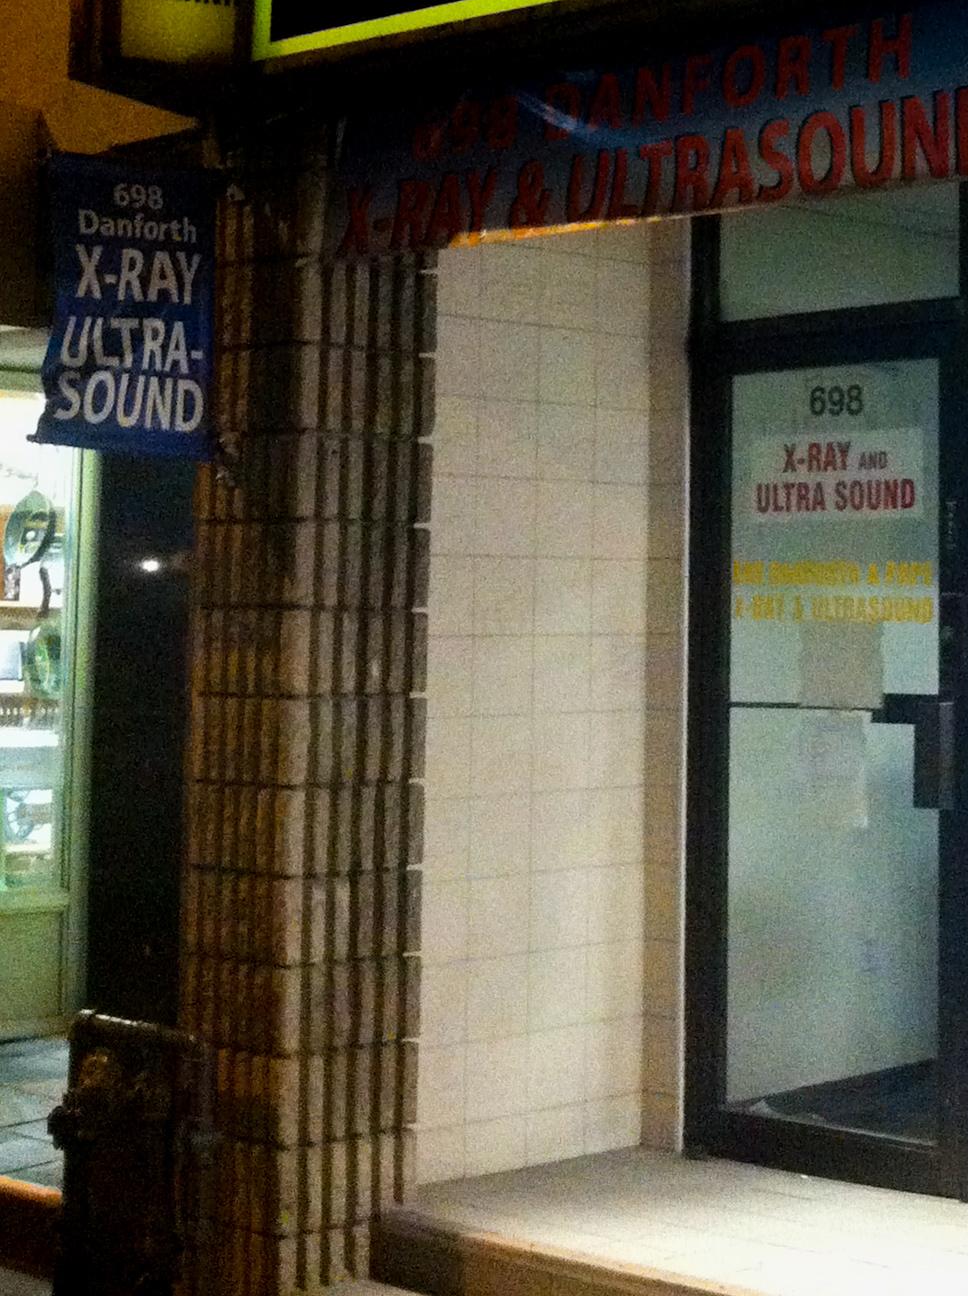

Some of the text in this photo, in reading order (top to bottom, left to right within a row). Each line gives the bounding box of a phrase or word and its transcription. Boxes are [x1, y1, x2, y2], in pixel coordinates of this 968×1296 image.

[545, 13, 914, 142] DANFORTH
[114, 183, 164, 210] 698
[337, 165, 498, 256] X-RAY
[508, 159, 550, 229] &
[78, 208, 197, 244] Danforth
[75, 243, 201, 305] X-RAY
[60, 315, 203, 374] ULTRA-
[53, 370, 204, 432] SOUND
[810, 384, 864, 417] 698
[783, 441, 889, 473] X-RAY AND
[757, 478, 916, 514] ULTRA SOUND
